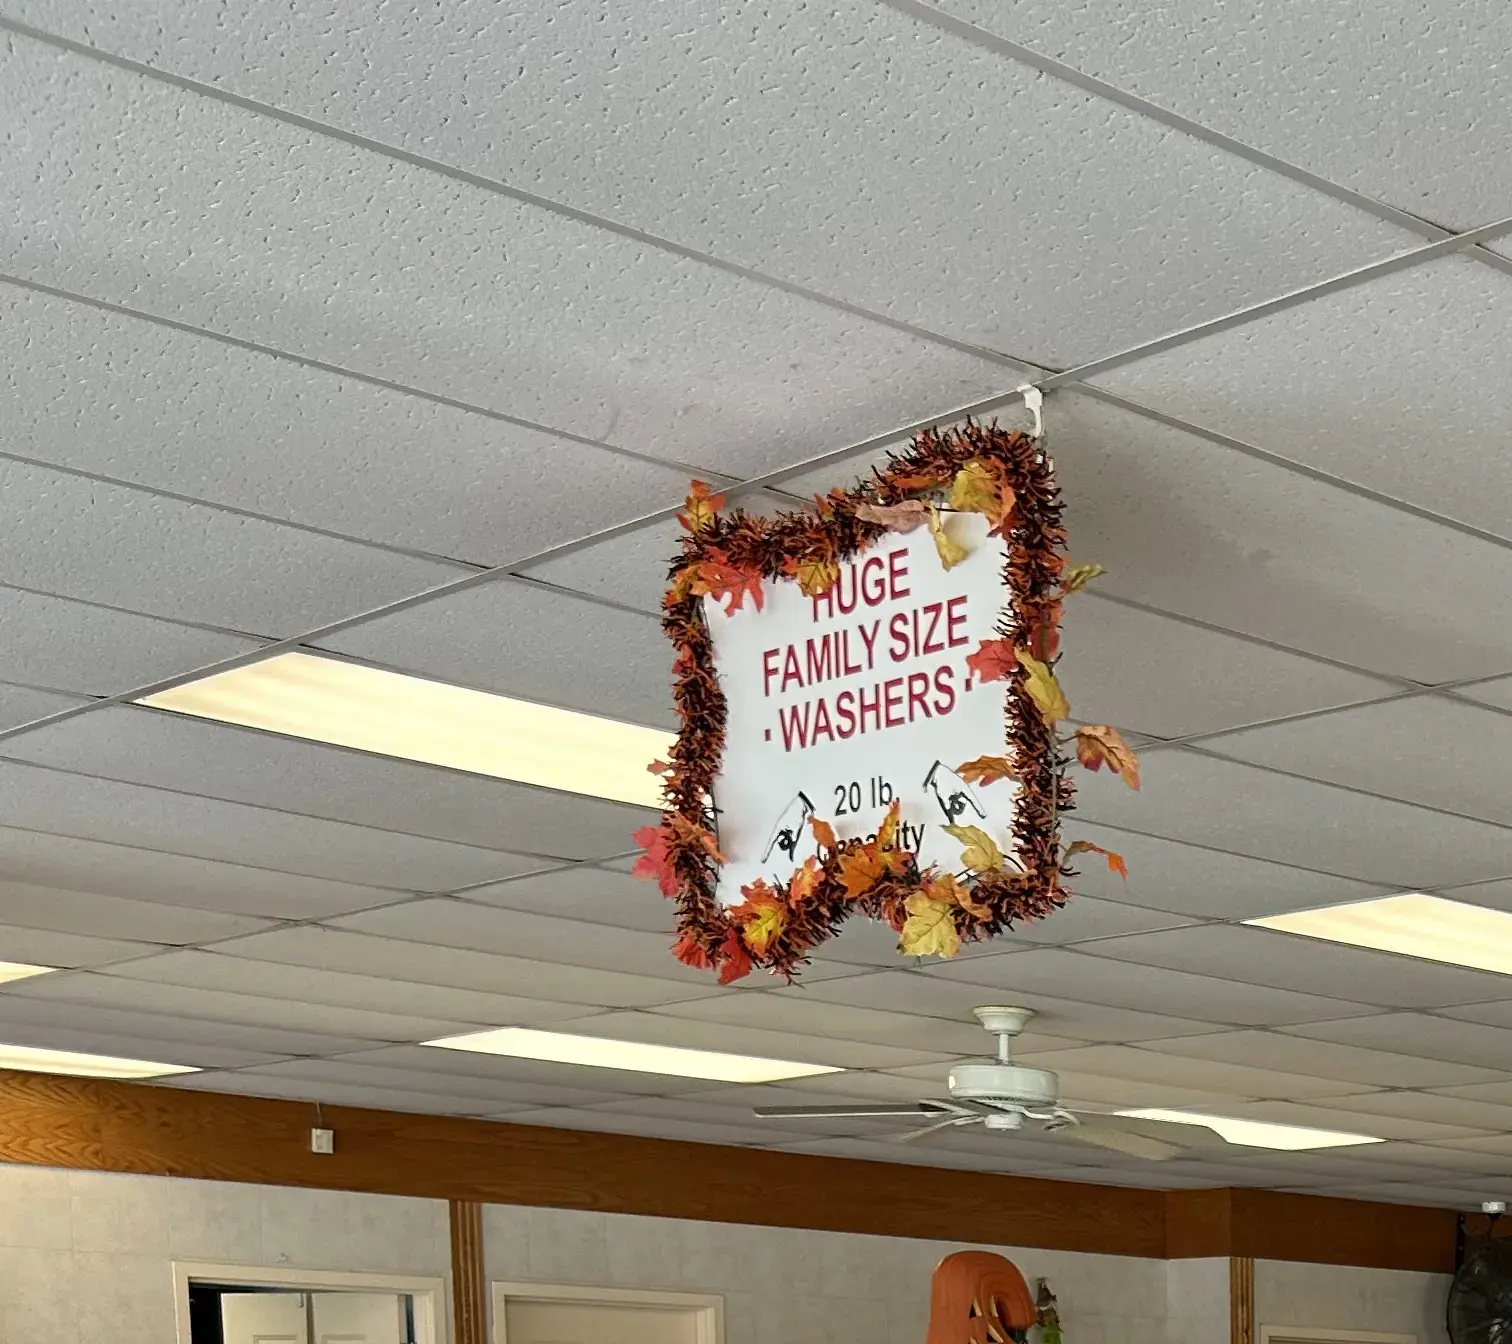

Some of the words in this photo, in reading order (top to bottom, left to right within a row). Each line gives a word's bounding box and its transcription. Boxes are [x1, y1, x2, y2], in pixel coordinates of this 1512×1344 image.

[813, 547, 911, 623] HUGE
[763, 619, 882, 697] FAMILY
[889, 595, 970, 663] SIZE
[779, 665, 956, 752] WASHERS
[834, 781, 862, 817] 20
